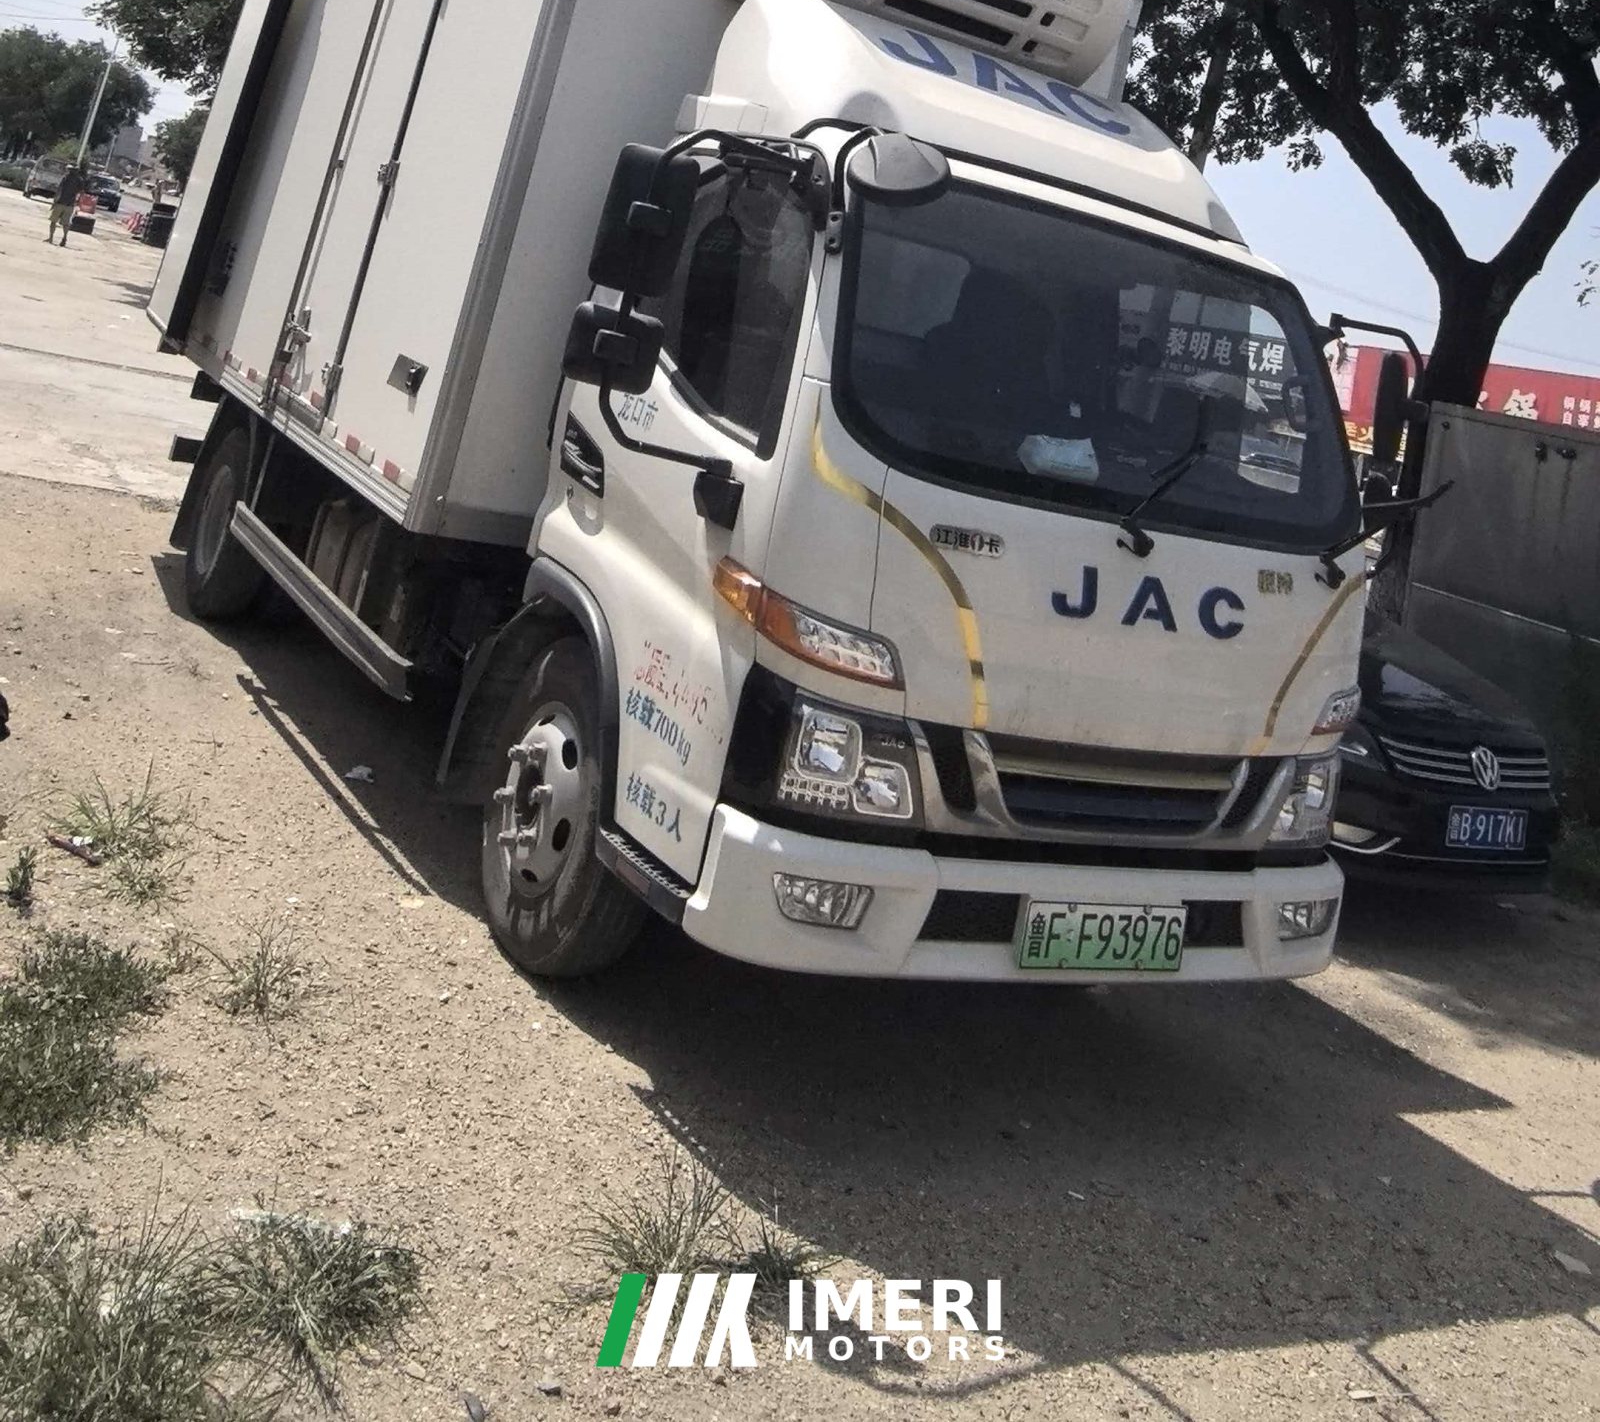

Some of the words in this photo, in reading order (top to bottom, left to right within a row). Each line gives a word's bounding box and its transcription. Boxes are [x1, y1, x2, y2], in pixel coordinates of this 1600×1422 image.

[880, 29, 1131, 136] JAC
[1165, 327, 1286, 376] 黎明电气焊
[1050, 564, 1246, 640] JAC
